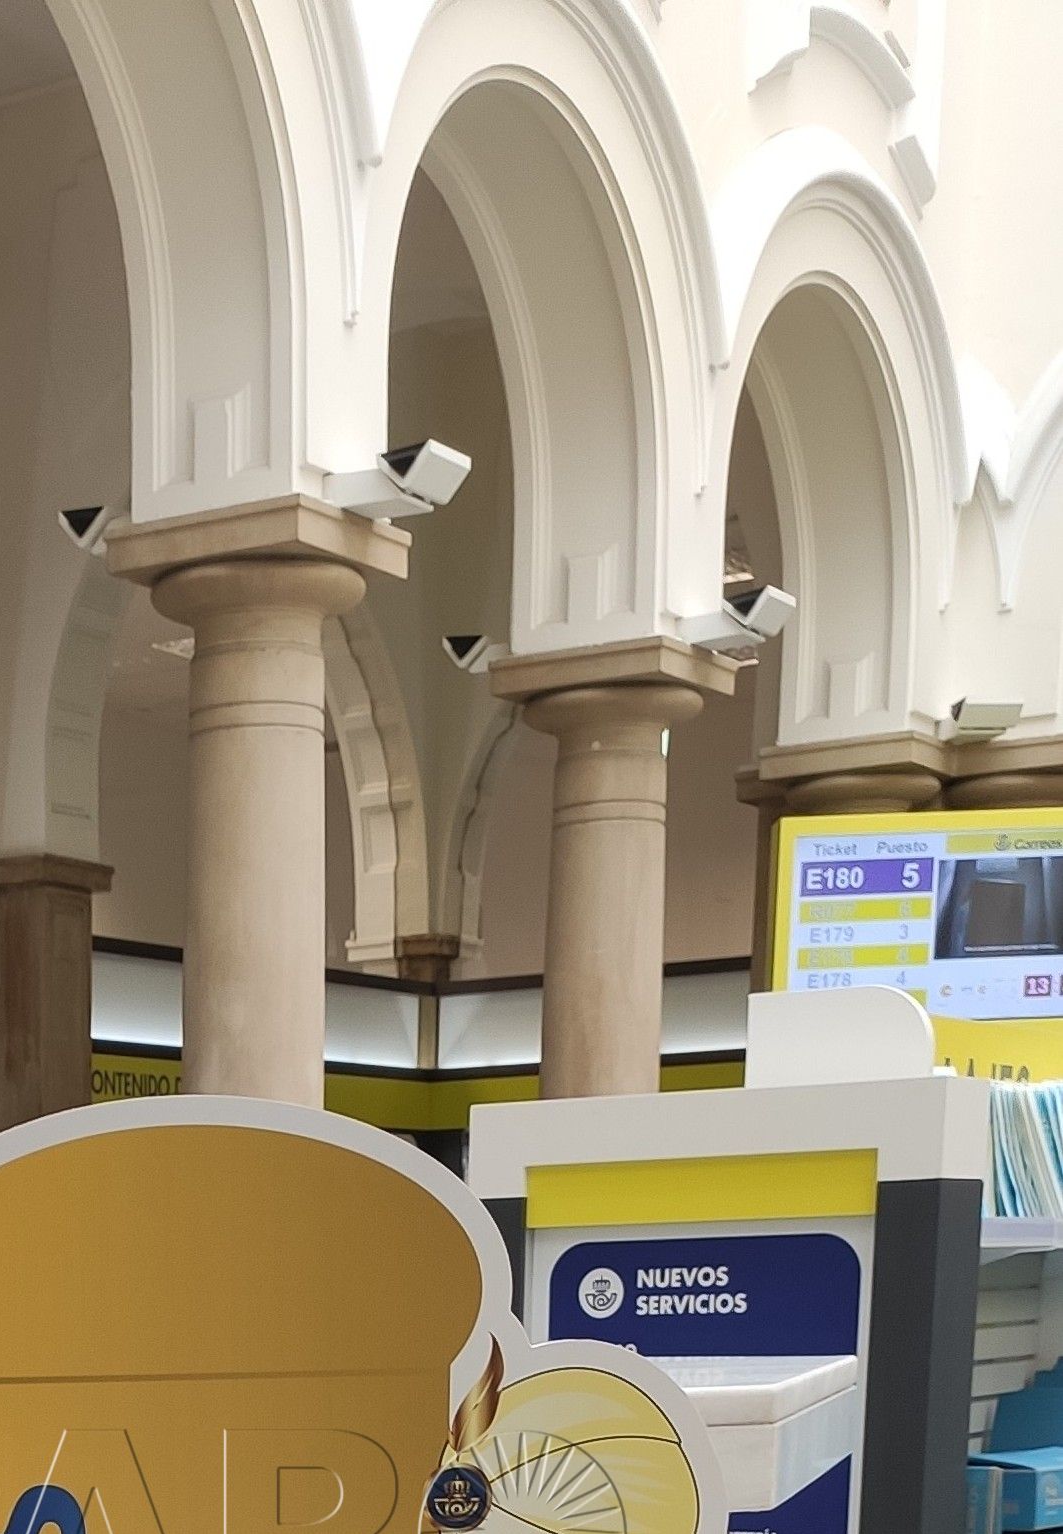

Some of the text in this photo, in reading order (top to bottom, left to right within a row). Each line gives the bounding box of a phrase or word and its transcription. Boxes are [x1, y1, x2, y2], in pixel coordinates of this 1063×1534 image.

[812, 840, 928, 857] Ticket Puesto
[805, 862, 921, 891] E180 5
[809, 923, 910, 943] E179 3
[807, 970, 908, 989] E178 4
[637, 1266, 730, 1289] NUEVOS
[635, 1294, 748, 1316] SERVICIOS
